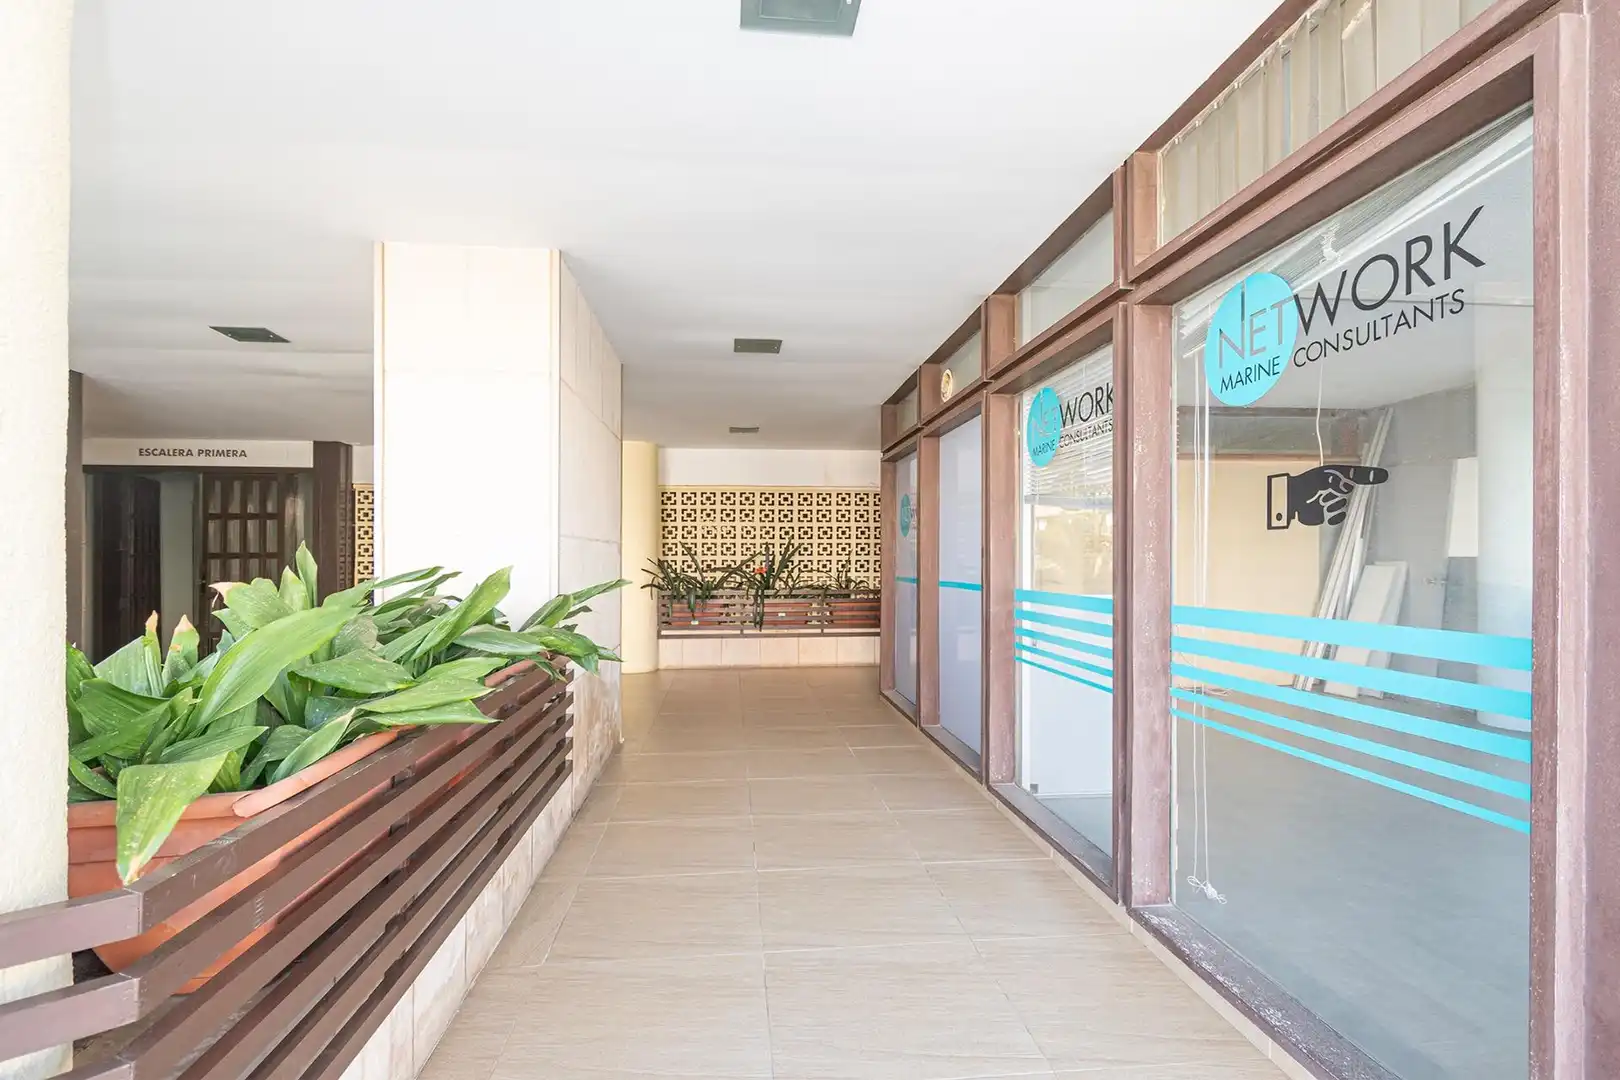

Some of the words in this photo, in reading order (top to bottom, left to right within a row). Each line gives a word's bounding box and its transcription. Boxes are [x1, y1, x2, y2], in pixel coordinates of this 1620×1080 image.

[1219, 205, 1486, 369] NETWORK
[1219, 355, 1281, 394] MARINE
[1293, 288, 1465, 368] CONSULTANTS
[138, 448, 194, 457] ESCALERA
[197, 448, 247, 457] PRIMERA
